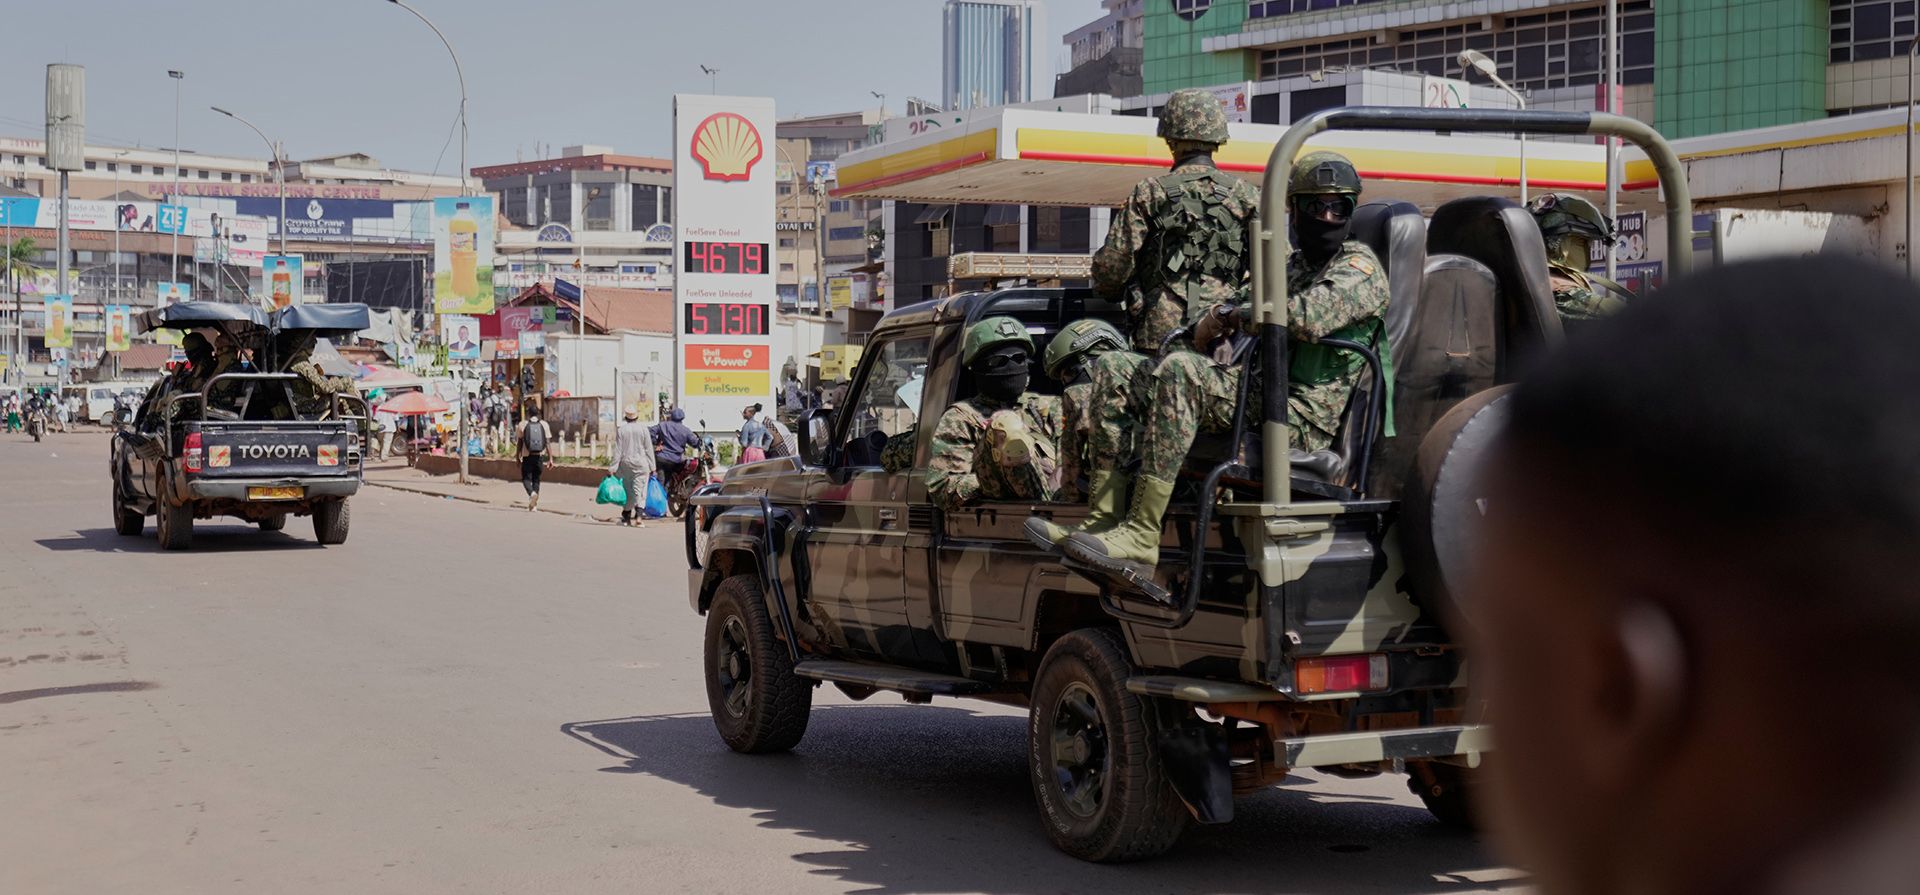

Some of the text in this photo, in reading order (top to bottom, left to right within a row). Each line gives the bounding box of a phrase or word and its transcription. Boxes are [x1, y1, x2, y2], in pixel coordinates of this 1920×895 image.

[149, 184, 189, 195] PARK
[196, 184, 234, 196] VIEW
[322, 187, 380, 199] CENTRE
[1622, 218, 1641, 231] HUB
[686, 227, 740, 237] FuelSave Diesel
[692, 241, 762, 275] 4679
[686, 289, 752, 298] FuelSave Unleaded
[703, 348, 720, 357] Shell
[703, 357, 748, 367] V-Power
[704, 384, 750, 393] FuelSave
[239, 445, 310, 459] TOYOTA
